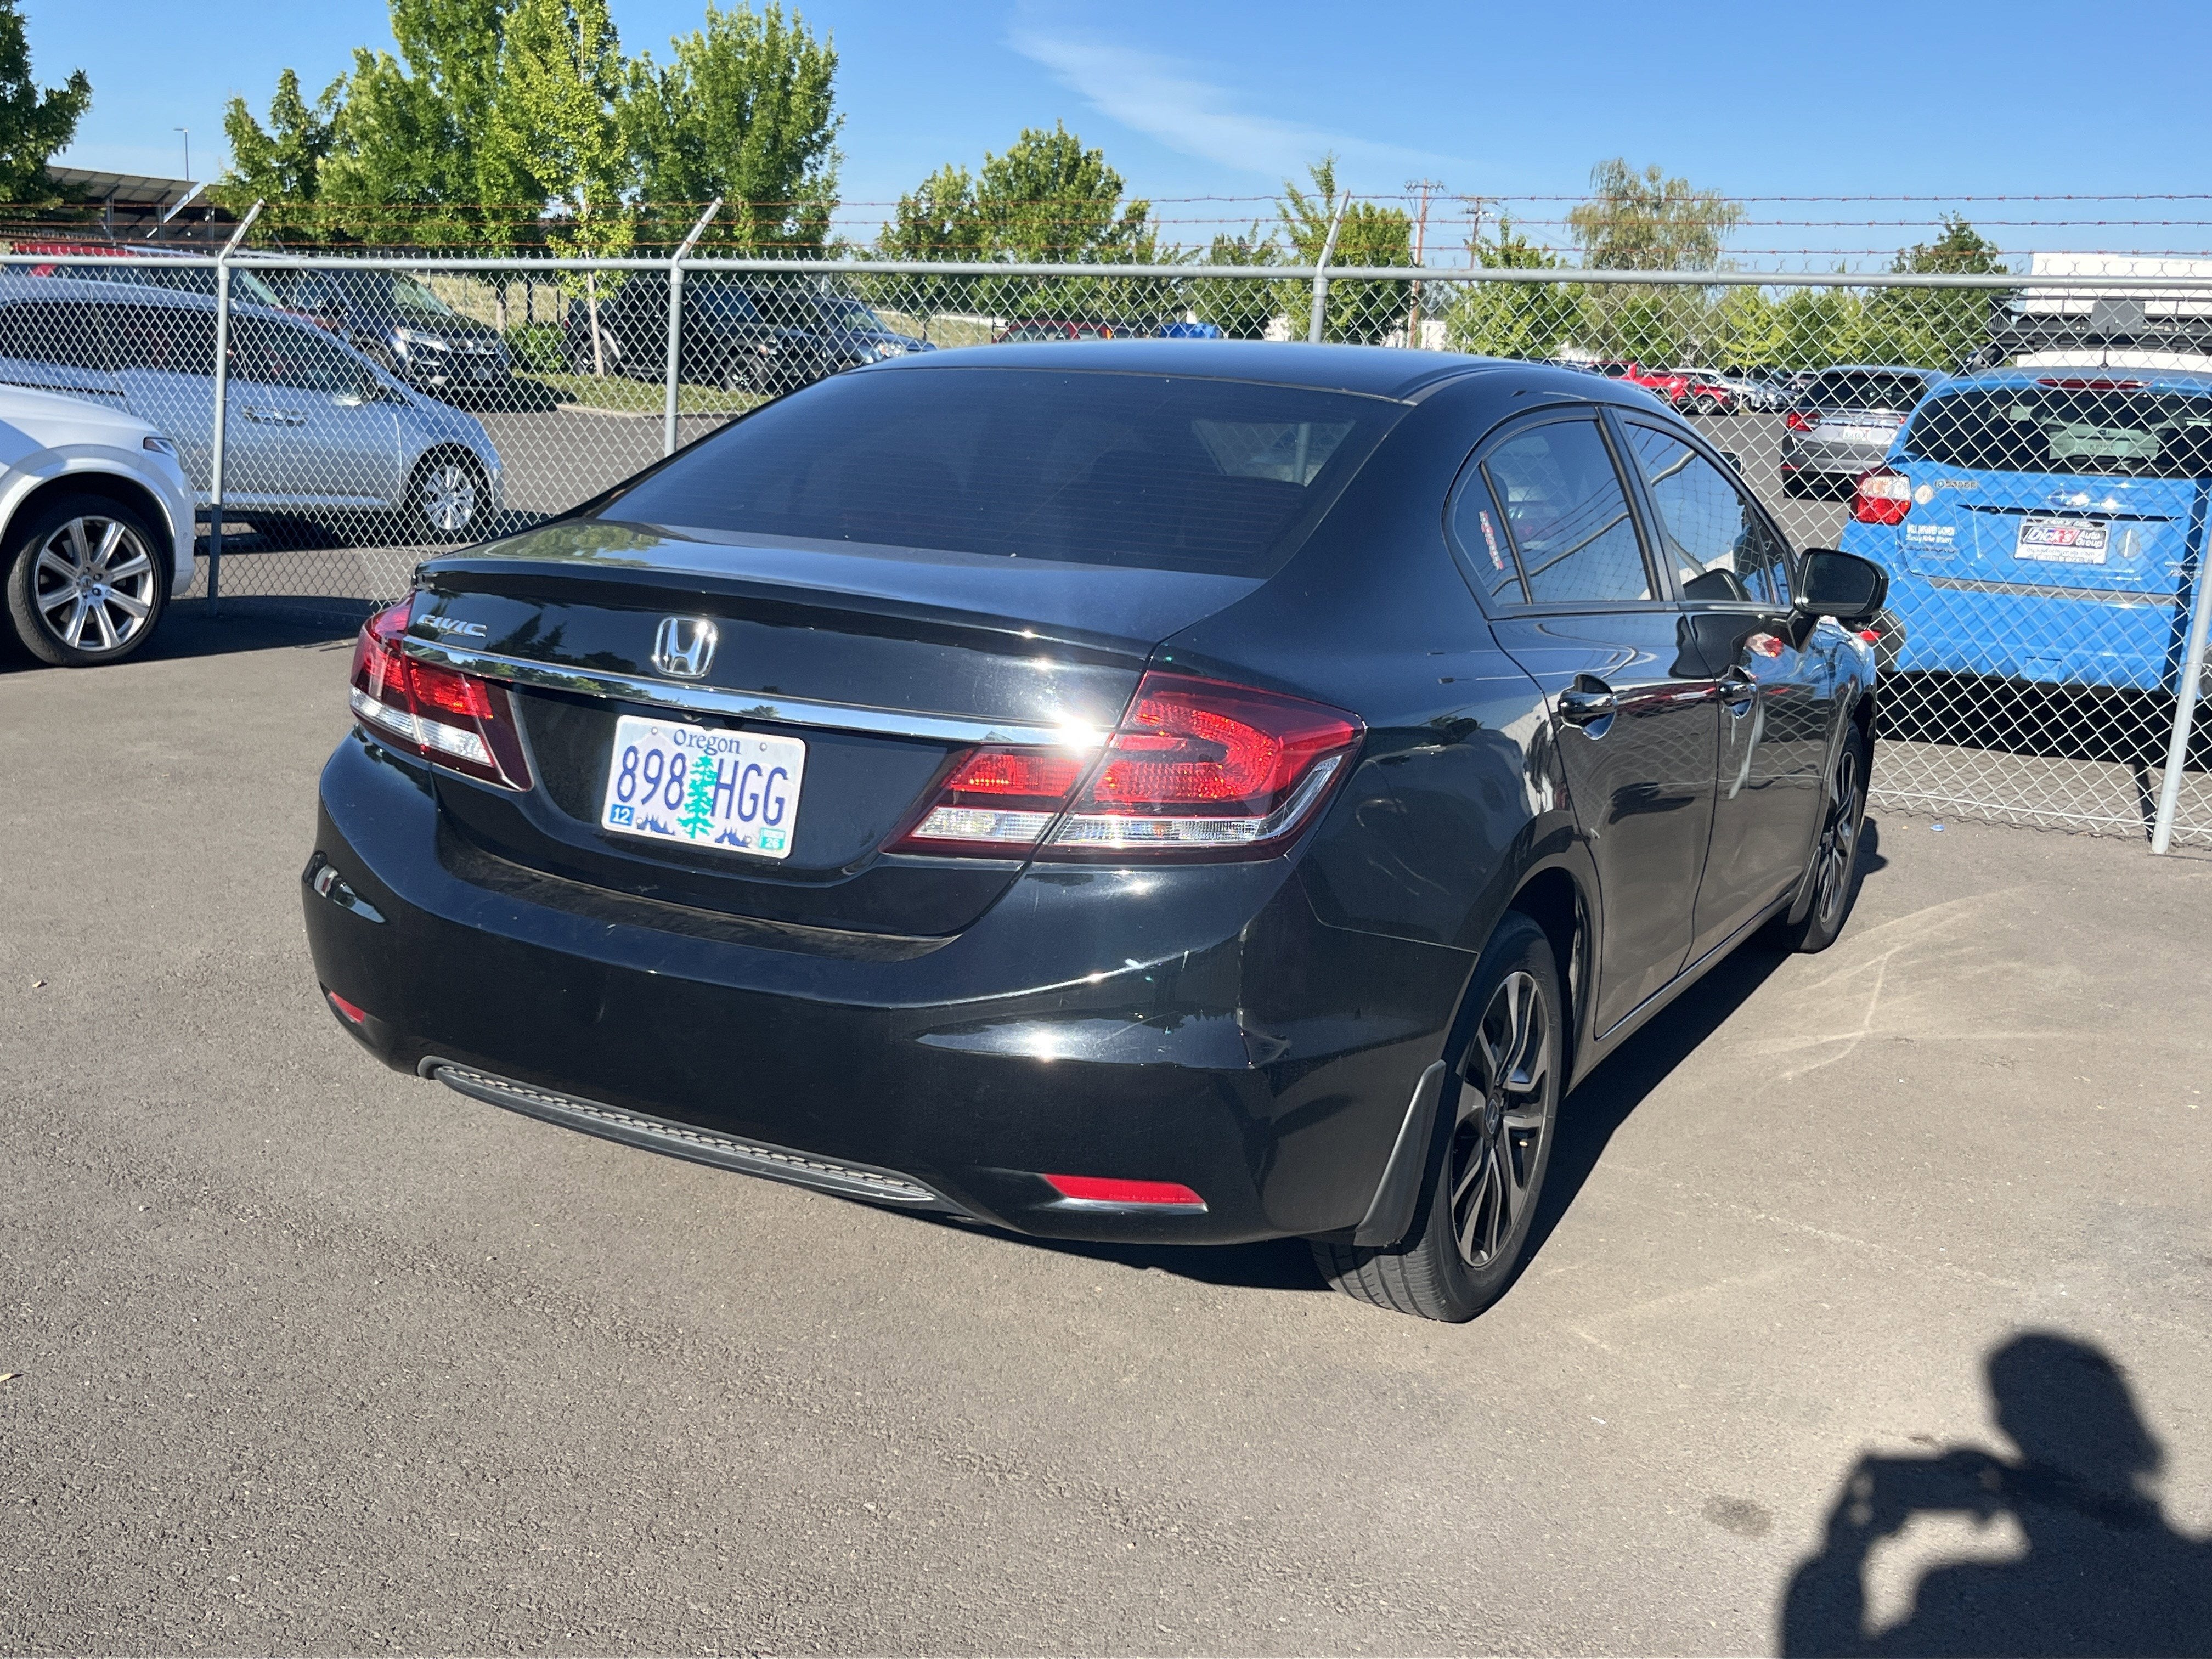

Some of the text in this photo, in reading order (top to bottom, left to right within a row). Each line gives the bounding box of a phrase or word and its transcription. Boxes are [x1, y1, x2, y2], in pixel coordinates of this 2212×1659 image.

[2027, 528, 2073, 543] Dick's
[2075, 538, 2103, 548] Group
[2079, 530, 2101, 540] Auto
[417, 614, 487, 637] CIVIC
[674, 729, 742, 756] Oregon
[617, 746, 788, 826] 898 HGG
[612, 806, 630, 824] 12
[765, 837, 780, 849] 26
